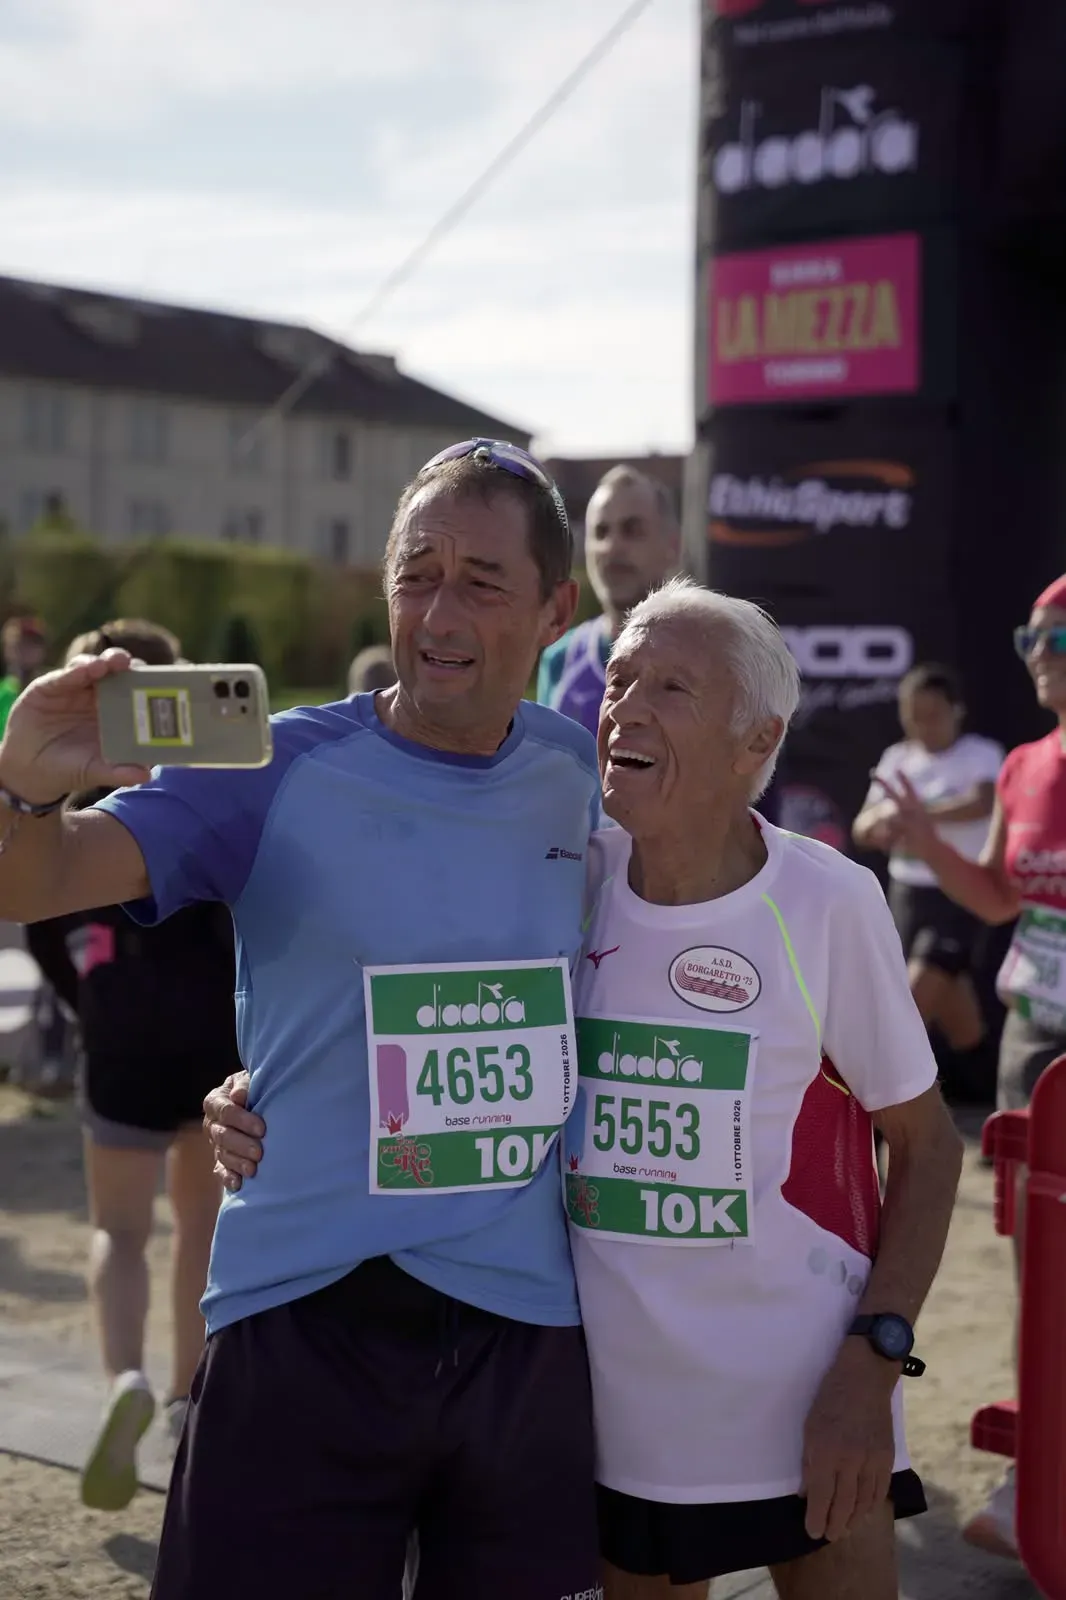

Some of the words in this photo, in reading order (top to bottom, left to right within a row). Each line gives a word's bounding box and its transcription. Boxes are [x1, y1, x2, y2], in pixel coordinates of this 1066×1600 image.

[687, 963, 741, 983] BORGARETTO
[711, 957, 733, 969] A.S.D.
[416, 981, 526, 1028] diadora
[560, 1034, 569, 1056] 2026
[597, 1032, 704, 1083] diadora
[416, 1044, 534, 1106] 4653
[563, 1059, 571, 1103] OTTOBRE
[445, 1115, 471, 1127] base
[472, 1114, 512, 1125] running
[592, 1093, 701, 1161] 5553
[733, 1099, 742, 1122] 2026
[734, 1125, 742, 1169] OTTOBRE
[613, 1162, 637, 1175] base
[638, 1167, 677, 1182] running
[735, 1172, 743, 1182] 11
[640, 1189, 742, 1234] 10K
